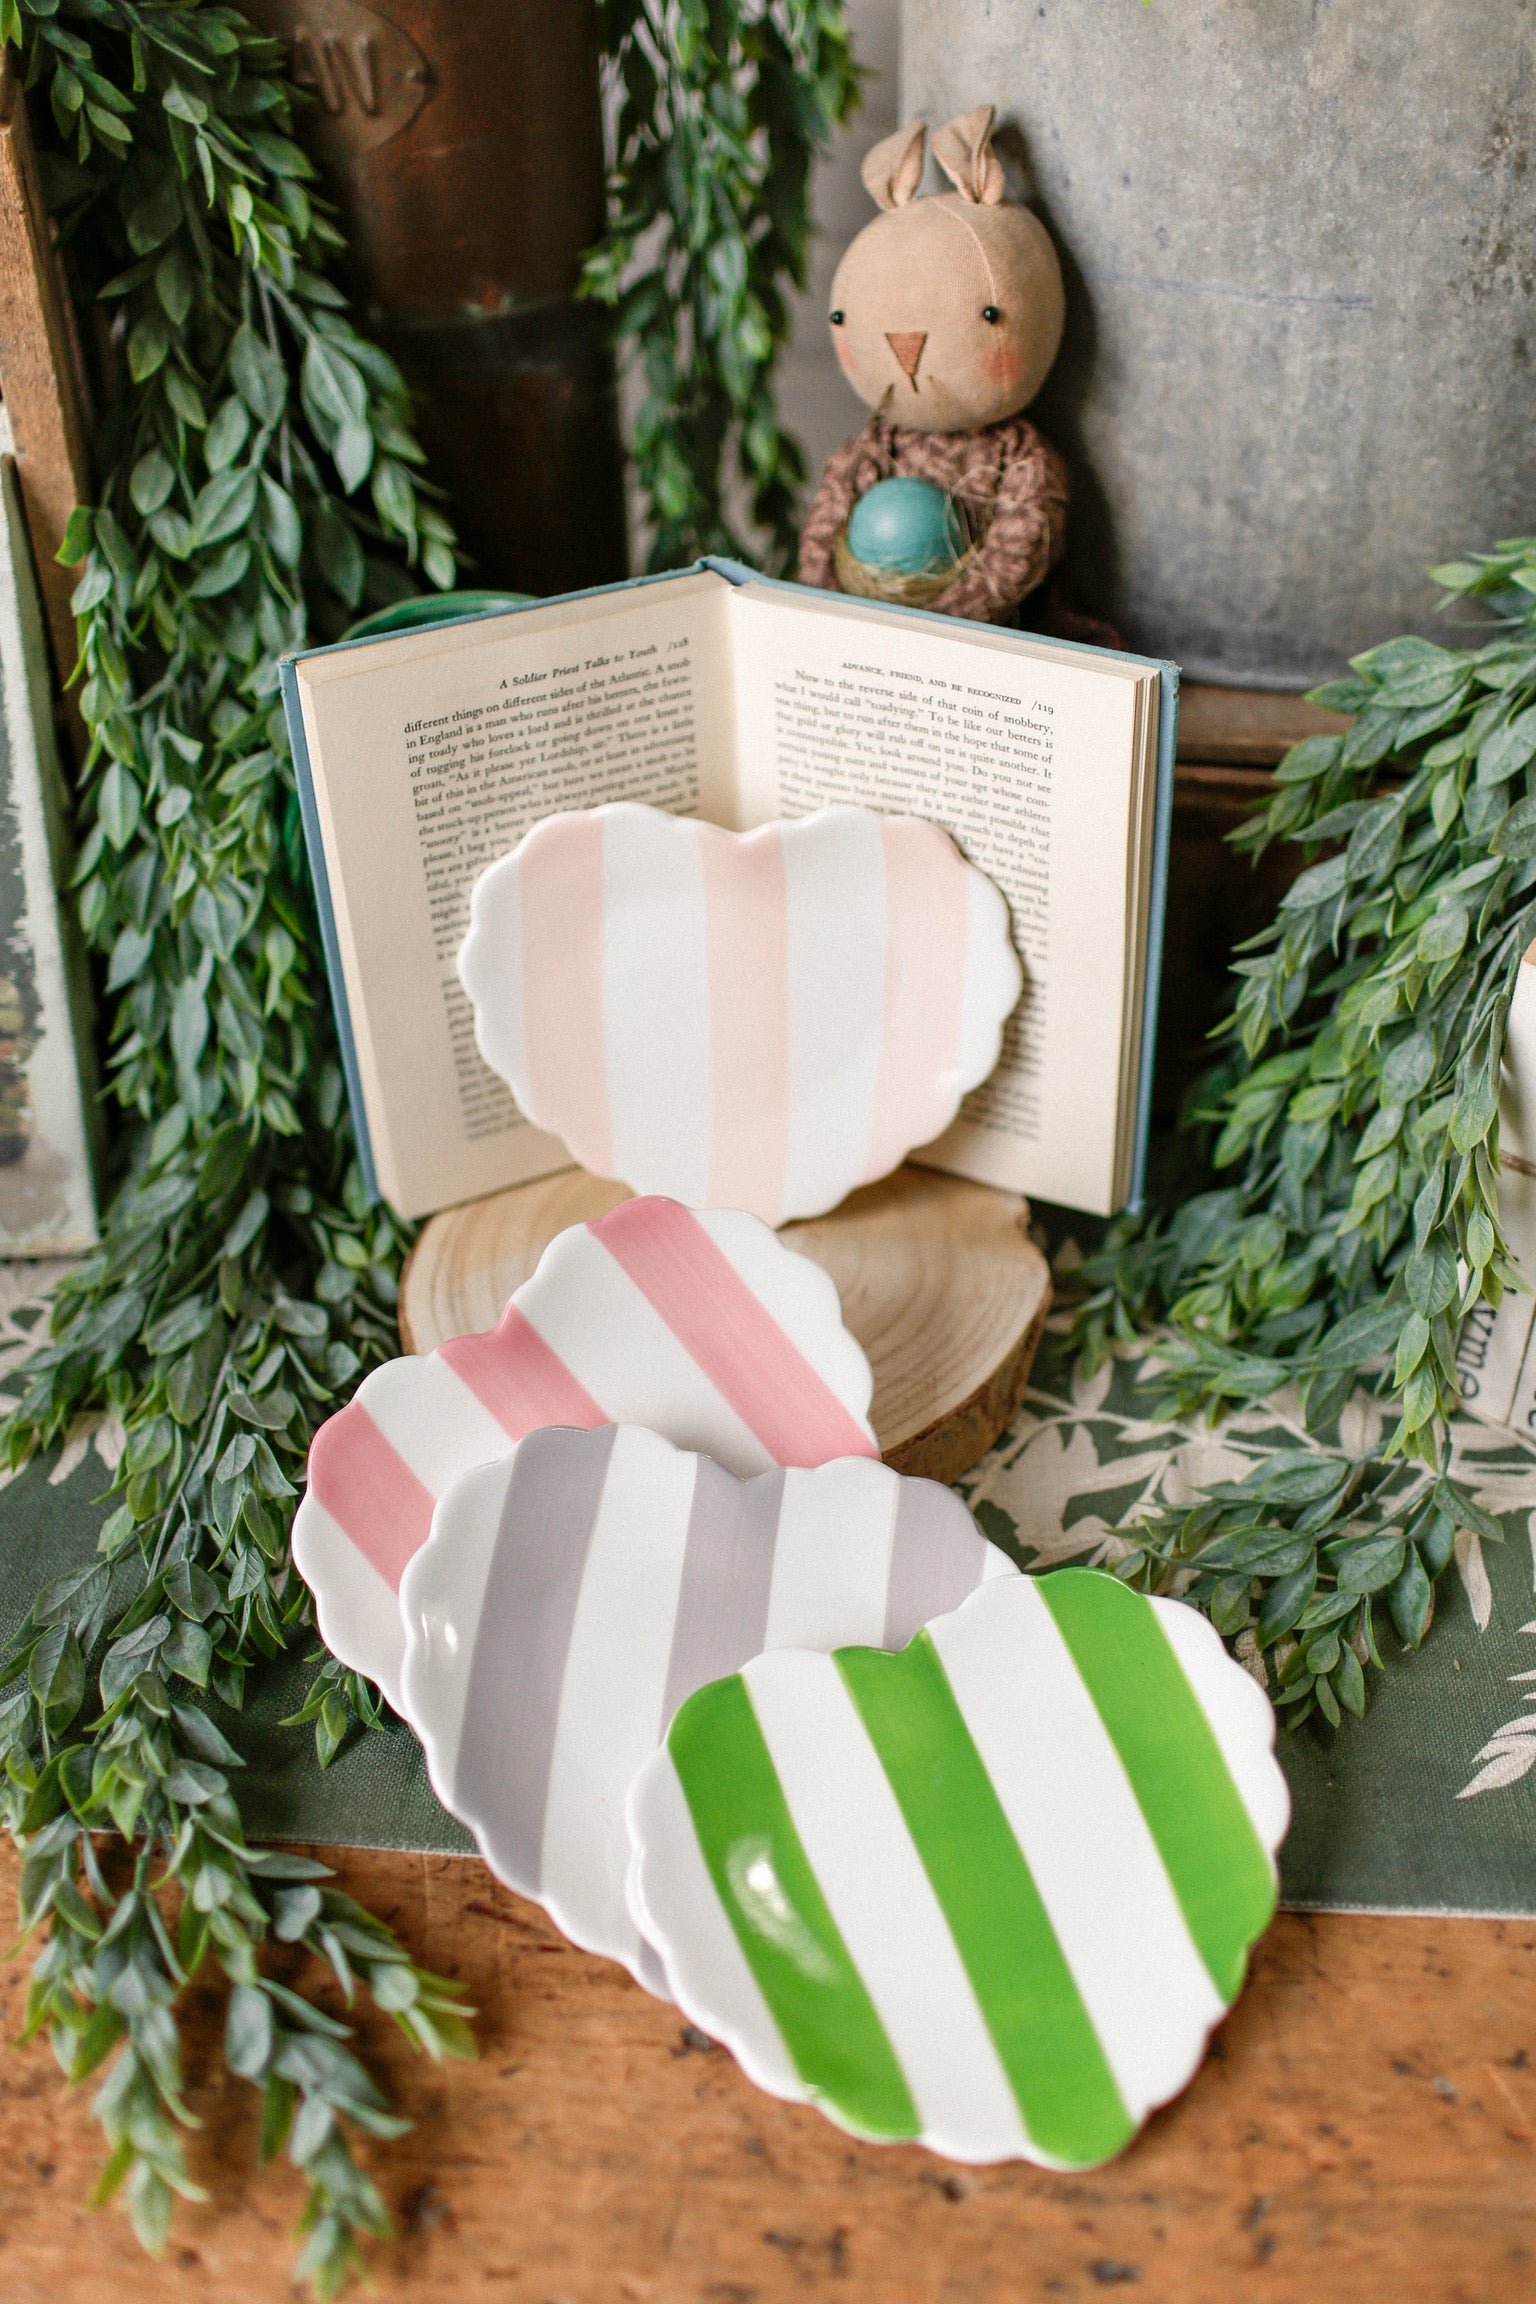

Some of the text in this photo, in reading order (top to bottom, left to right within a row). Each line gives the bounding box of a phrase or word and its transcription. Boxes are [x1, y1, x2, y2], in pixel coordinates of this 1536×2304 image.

[498, 680, 508, 689] A
[513, 673, 547, 686] Soldier
[553, 664, 579, 677] Priest
[585, 656, 609, 669] Talks
[630, 644, 657, 659] Youth
[842, 662, 884, 676] ADVANCE,
[891, 671, 923, 684] FRIEND,
[929, 678, 946, 688] AND
[968, 687, 1021, 705] RECOGNIZED
[1032, 700, 1054, 715] /119
[404, 716, 448, 733] different
[453, 709, 483, 721] things
[487, 705, 499, 713] on
[503, 693, 547, 709] different
[551, 687, 573, 698] sides
[577, 682, 587, 692] of
[591, 678, 605, 689] the
[655, 664, 665, 673] A
[407, 740, 416, 748] in
[420, 726, 462, 745] England
[467, 725, 473, 733] is
[486, 718, 506, 728] man
[511, 711, 532, 722] who
[537, 707, 558, 717] runs
[563, 701, 584, 711] after
[588, 695, 601, 705] his
[644, 681, 658, 691] the
[795, 671, 1053, 736] Now to the reverse side of that coin of snobbery,
[409, 754, 425, 764] ing
[430, 744, 458, 758] toady
[463, 737, 484, 749] who
[489, 732, 513, 742] loves
[528, 721, 548, 734] lord
[554, 716, 571, 728] and
[575, 715, 582, 723] is
[587, 704, 621, 720] thrilled
[640, 697, 654, 707] the
[845, 697, 860, 706] call
[928, 711, 943, 722] To
[949, 716, 959, 726] be
[964, 719, 981, 731] like
[986, 727, 1003, 737] our
[1009, 730, 1041, 746] betters
[1046, 740, 1053, 749] is
[857, 715, 873, 723] run
[878, 717, 900, 728] after
[905, 722, 928, 734] them
[932, 727, 941, 737] in
[945, 730, 960, 741] the
[964, 734, 987, 750] hope
[991, 741, 1010, 753] that
[1014, 749, 1038, 760] some
[1042, 755, 1053, 764] of
[410, 767, 421, 778] of
[427, 759, 466, 775] tugging
[470, 753, 483, 762] his
[489, 741, 530, 758] forelock
[552, 732, 579, 748] going
[866, 731, 885, 740] will
[889, 735, 906, 745] rub
[911, 738, 924, 748] off
[929, 744, 940, 752] on
[960, 749, 965, 758] is
[970, 754, 995, 765] quite
[1000, 761, 1039, 776] another.
[1045, 769, 1051, 779] It
[908, 754, 941, 766] around
[973, 766, 987, 777] Do
[993, 774, 1011, 784] you
[1017, 780, 1031, 789] not
[1038, 785, 1051, 794] see
[413, 780, 445, 796] groan,
[473, 769, 480, 777] it
[485, 762, 513, 777] please
[415, 797, 428, 807] bit
[432, 792, 442, 802] of
[446, 788, 464, 799] this
[467, 786, 476, 794] in
[480, 780, 495, 790] the
[499, 770, 548, 786] American
[931, 772, 941, 781] of
[944, 777, 967, 787] your
[973, 783, 987, 794] age
[993, 787, 1022, 801] whose
[1027, 797, 1051, 807] com-
[417, 807, 444, 821] based
[448, 805, 461, 813] on
[917, 783, 937, 798] they
[944, 791, 956, 799] are
[962, 794, 988, 806] either
[994, 803, 1009, 812] star
[1016, 808, 1050, 823] athletes
[419, 825, 434, 836] the
[990, 817, 1026, 831] possible
[1032, 826, 1049, 837] that
[1009, 833, 1035, 848] depth
[1039, 843, 1049, 852] of
